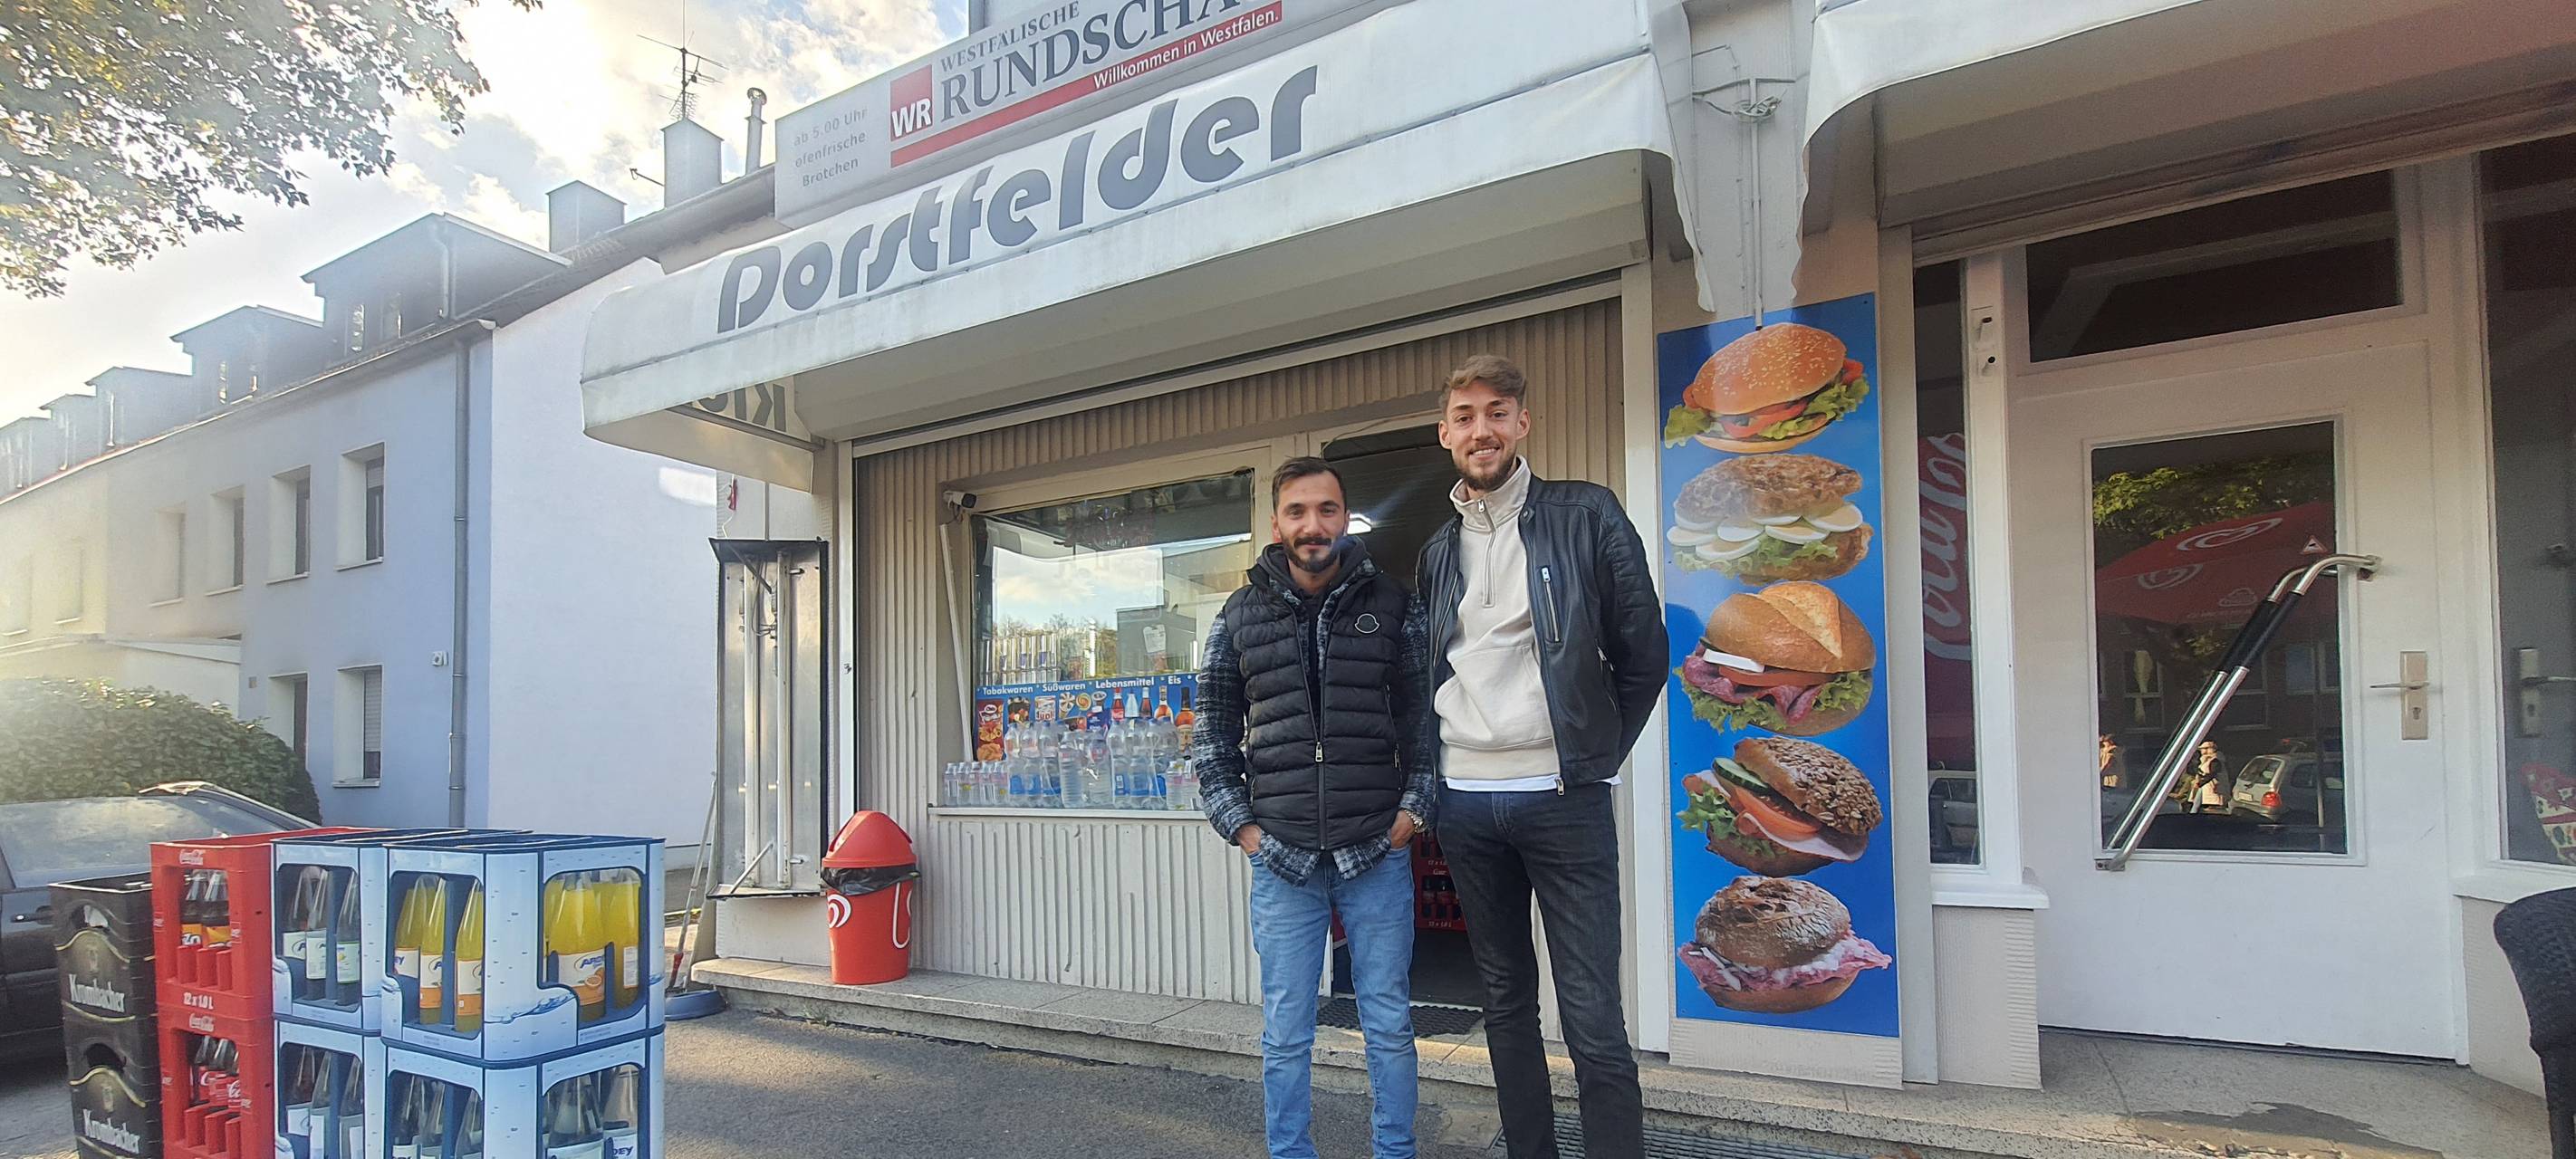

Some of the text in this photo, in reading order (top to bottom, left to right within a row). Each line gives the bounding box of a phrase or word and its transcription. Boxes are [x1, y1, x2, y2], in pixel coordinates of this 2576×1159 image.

[940, 0, 1080, 72] WESTFÄLISCHE
[1093, 10, 1279, 89] Willkommen in Westfalen.
[793, 108, 868, 147] ab 5.00 Uhr
[891, 98, 932, 138] WR
[795, 131, 866, 168] ofenfrische
[717, 65, 1318, 334] Dorstfelder
[983, 675, 1182, 695] Tabakwaren Süßwaren Lebensmittel Eis
